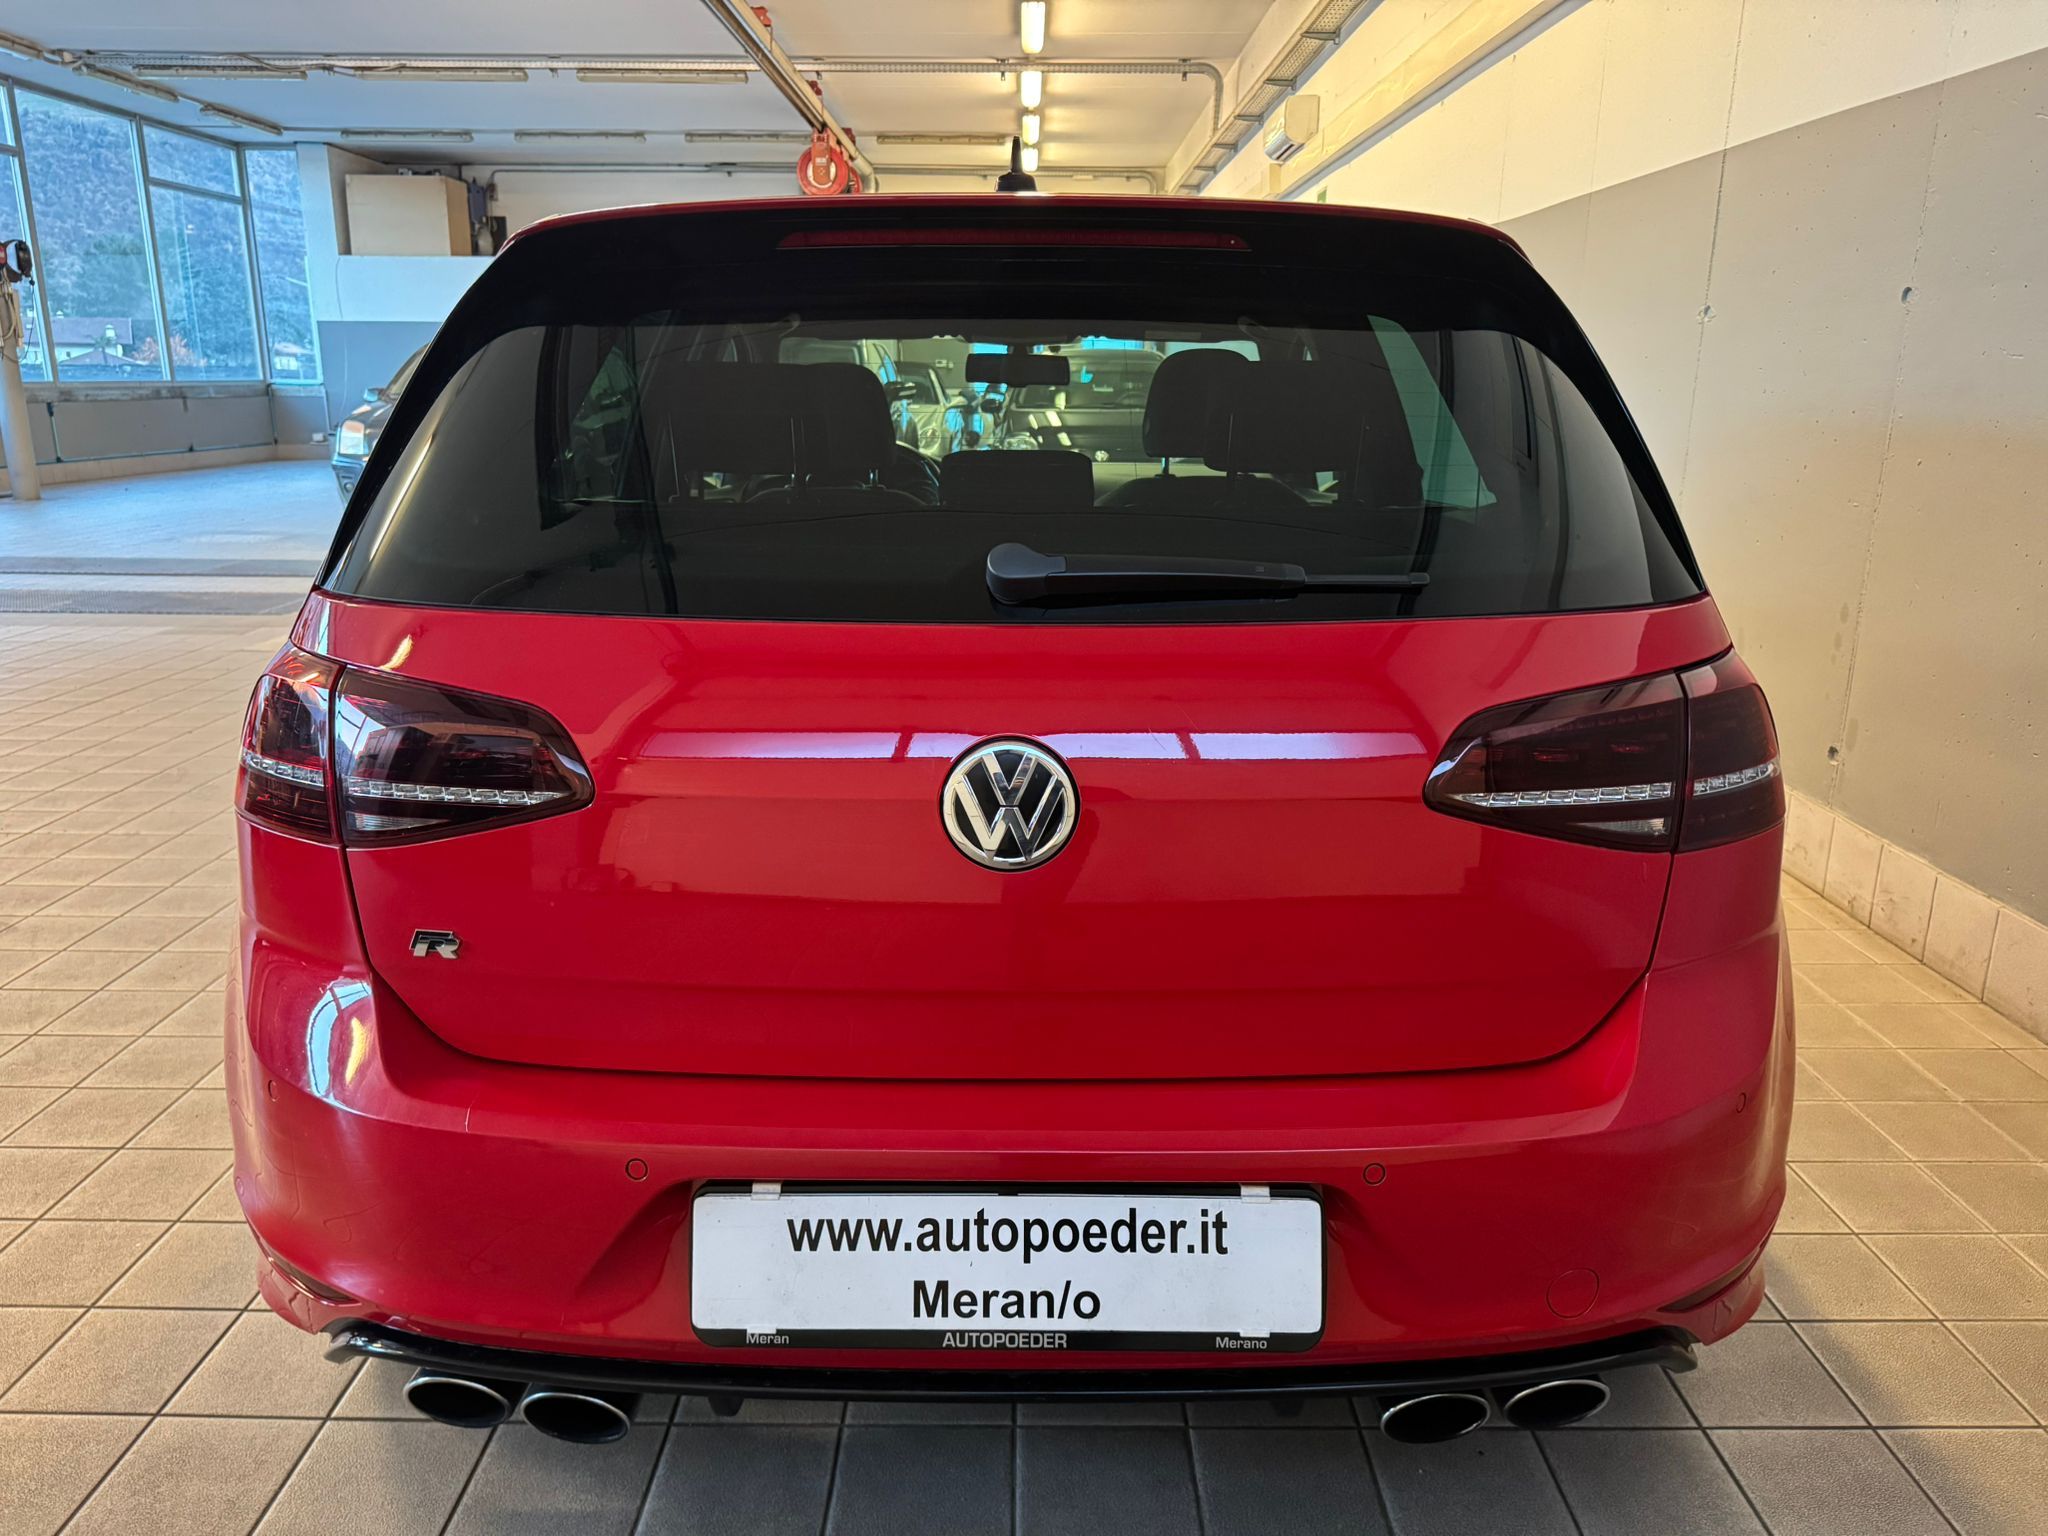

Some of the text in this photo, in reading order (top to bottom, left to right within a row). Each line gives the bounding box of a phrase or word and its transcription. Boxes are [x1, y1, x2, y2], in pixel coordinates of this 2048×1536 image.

[408, 928, 460, 959] R
[786, 1207, 1229, 1264] www.autopoeder.it
[911, 1279, 1102, 1320] Meran/o
[746, 1333, 789, 1345] Meran
[942, 1332, 1068, 1349] AUTOPOEDER
[1215, 1336, 1268, 1350] Merano
